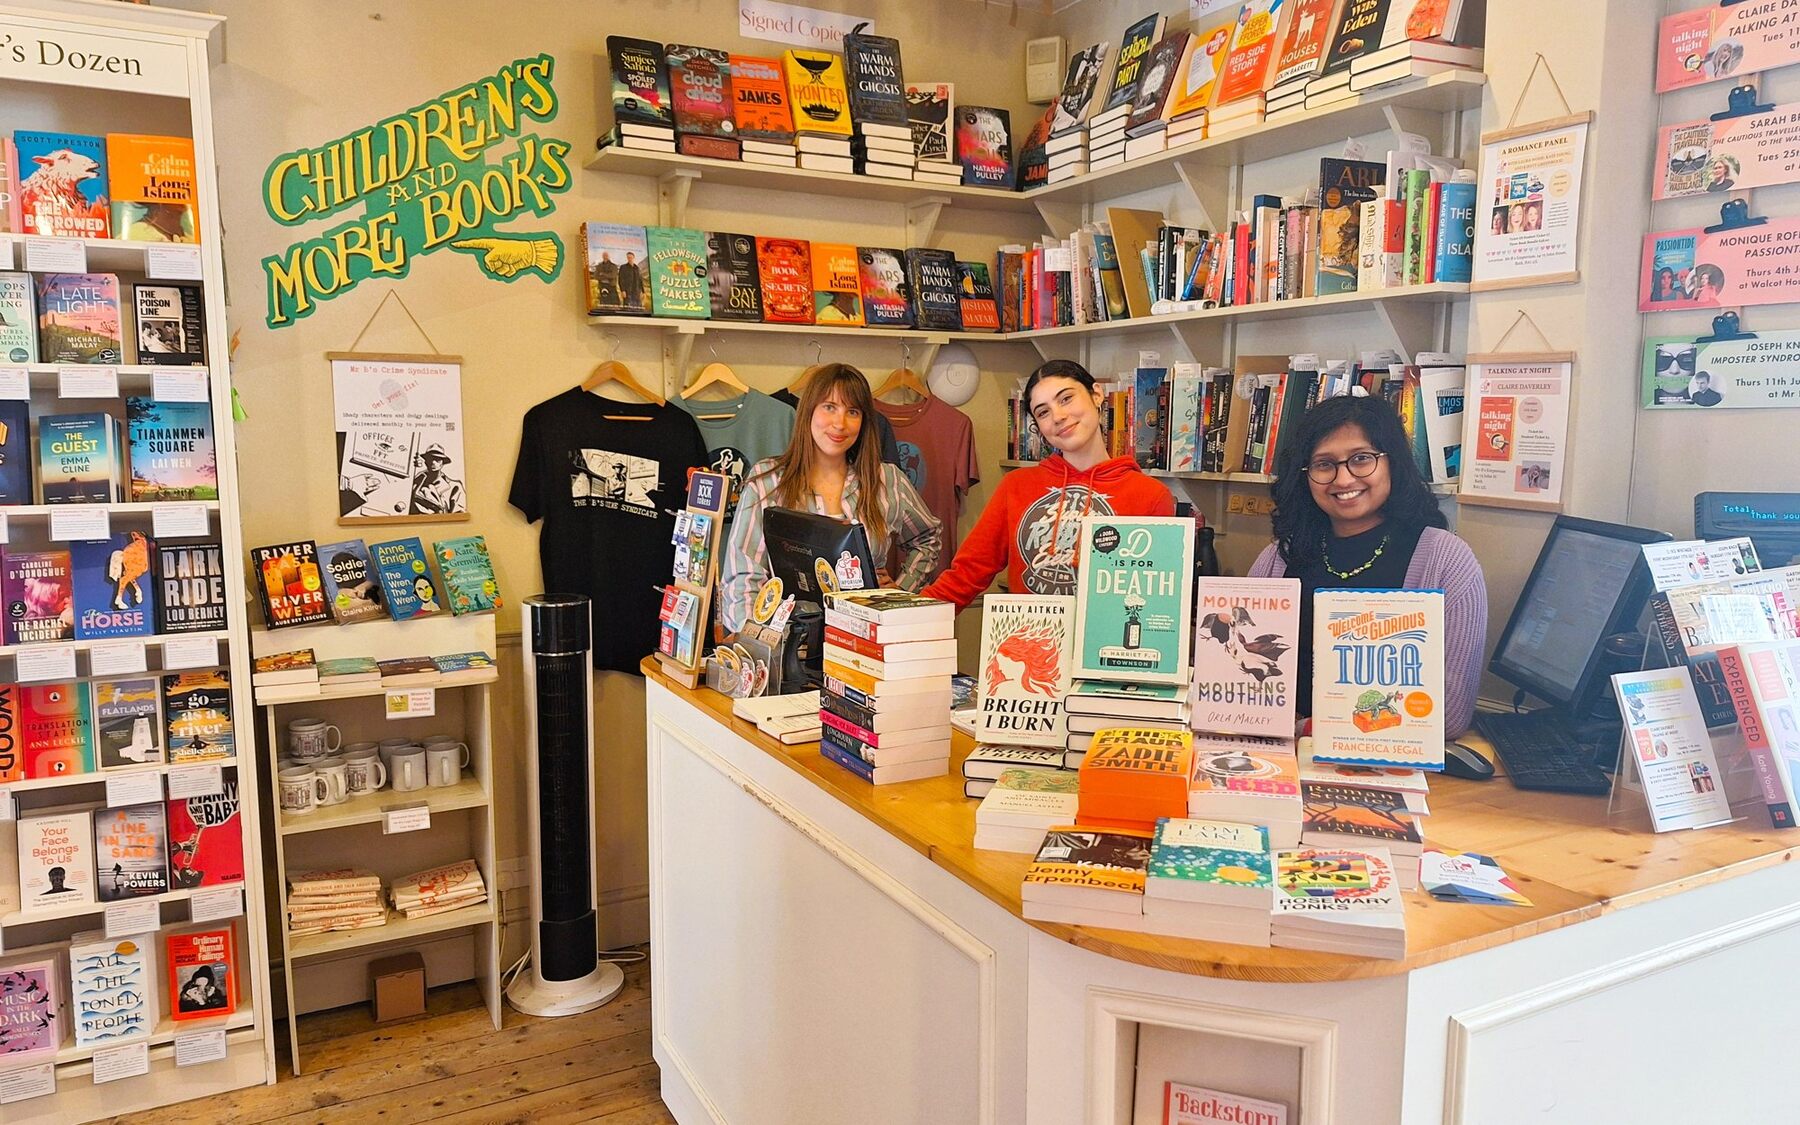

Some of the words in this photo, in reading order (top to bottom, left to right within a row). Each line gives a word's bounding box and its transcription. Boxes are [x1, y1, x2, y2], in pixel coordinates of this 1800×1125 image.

[1737, 2, 1776, 20] CLAIRE
[741, 9, 793, 33] Signed
[1341, 11, 1379, 36] Eden
[1728, 17, 1778, 37] TALKING
[1781, 12, 1797, 24] AT
[1671, 28, 1709, 45] talking
[1763, 32, 1784, 43] Tues
[37, 40, 143, 76] Dozen
[859, 52, 894, 67] WARM
[1280, 42, 1318, 66] HOUSES
[860, 65, 895, 78] HANDS
[1116, 60, 1141, 88] PARTY
[631, 80, 653, 90] HEART
[682, 72, 722, 89] cloud
[859, 80, 900, 96] GHOSTS
[737, 89, 782, 105] JAMES
[1750, 117, 1787, 129] SARAH
[268, 59, 554, 222] CHILDREN'S
[929, 136, 944, 145] Paul
[1727, 133, 1763, 143] CAUTIOUS
[1769, 138, 1782, 146] THE
[925, 142, 947, 152] Lynch
[1508, 141, 1543, 154] ROMANCE
[1544, 137, 1568, 148] PANEL
[1757, 153, 1779, 162] Tues
[975, 172, 1003, 181] PULLEY
[386, 162, 458, 207] AND
[143, 186, 191, 200] Island
[25, 216, 104, 231] BORROWED
[268, 211, 405, 324] MORE
[419, 138, 568, 249] BOOKS
[1656, 237, 1695, 251] PASSIONTIDE
[1719, 233, 1773, 247] MONIQUE
[653, 249, 705, 266] FELLOWSHIP
[771, 266, 799, 276] BOOK
[921, 265, 951, 277] WARM
[1746, 267, 1771, 277] Thurs
[1775, 266, 1791, 275] 4th
[660, 275, 701, 288] PUZZLE
[829, 279, 858, 290] Island
[833, 272, 857, 284] Long
[921, 275, 953, 288] HANDS
[1739, 281, 1748, 290] at
[1751, 279, 1783, 289] Walcot
[61, 287, 101, 301] LATE
[139, 290, 156, 299] THE
[659, 287, 703, 300] MAKERS
[730, 286, 756, 299] DAY
[921, 291, 957, 304] GHOSTS
[57, 301, 108, 314] LIGHT
[139, 299, 171, 308] POISON
[729, 297, 758, 309] ONE
[873, 304, 905, 313] NATASHA
[140, 307, 160, 316] LINE
[876, 310, 904, 319] PULLEY
[67, 336, 102, 344] MICHAEL
[72, 341, 98, 349] MALAY
[1746, 342, 1782, 352] JOSEPH
[1711, 356, 1757, 365] IMPOSTER
[1736, 378, 1761, 387] Thurs
[1765, 377, 1786, 387] 11th
[1781, 390, 1795, 398] Mr
[1481, 411, 1512, 422] talking
[1484, 420, 1507, 430] night
[65, 432, 83, 441] THE
[137, 428, 206, 441] TIANANMEN
[362, 433, 394, 444] OFFICES
[51, 439, 98, 454] GUEST
[149, 440, 195, 454] SQUARE
[61, 456, 91, 466] EMMA
[152, 458, 167, 468] LAI
[62, 464, 91, 473] CLINE
[621, 504, 658, 519] SYNDICATE
[1094, 535, 1118, 544] WILDWOOD
[1119, 528, 1152, 558] D
[260, 543, 314, 561] RIVER
[378, 544, 405, 556] Anne
[162, 550, 222, 579] DARK
[380, 551, 415, 566] Enright
[1131, 560, 1153, 568] FOR
[326, 559, 368, 575] Soldier
[334, 570, 368, 583] Sailor
[386, 572, 401, 581] The
[1096, 569, 1175, 596] DEATH
[165, 577, 224, 607] RIDE
[391, 589, 407, 598] The
[270, 592, 324, 608] RIVER
[394, 596, 416, 606] Wren
[1203, 595, 1291, 611] MOUTHING
[341, 608, 361, 617] Claire
[991, 605, 1022, 613] MOLLY
[1027, 605, 1065, 614] AITKEN
[12, 621, 31, 631] THE
[81, 611, 144, 629] HORSE
[1327, 611, 1375, 638] WELCOME
[1369, 611, 1425, 641] GLORIOUS
[19, 629, 62, 641] INCIDENT
[1110, 651, 1142, 659] HARRIET
[1112, 659, 1149, 667] TOWNSON
[1332, 643, 1424, 687] TUGA
[1723, 655, 1761, 743] EXPERIENCED
[102, 704, 155, 715] FLATLANDS
[983, 698, 1062, 716] BRIGHT
[26, 718, 89, 731] TRANSLATION
[999, 715, 1055, 731] BURN
[1207, 711, 1231, 723] ORLA
[1237, 712, 1273, 726] MACKEY
[37, 729, 76, 739] STATE
[178, 722, 223, 737] river
[29, 740, 49, 749] ANN
[1098, 736, 1184, 747] FRAUD
[1093, 747, 1181, 763] ZADIE
[1332, 741, 1390, 754] FRANCESCA
[1393, 742, 1424, 756] SEGAL
[1088, 759, 1178, 772] SMITH
[1758, 754, 1768, 774] Kate
[1765, 775, 1776, 800] Young
[1227, 777, 1297, 794] RED
[1308, 785, 1394, 800] Roman
[205, 801, 239, 825] BABY
[42, 826, 67, 837] Your
[1186, 823, 1241, 835] TOM
[41, 836, 69, 846] Face
[1178, 830, 1248, 843] LAKE
[32, 844, 79, 858] Belongs
[41, 856, 55, 865] To
[58, 855, 72, 864] Us
[129, 871, 159, 880] KEVIN
[1028, 865, 1093, 878] Jenny
[124, 879, 166, 888] POWERS
[1023, 874, 1144, 891] Erpenbeck
[1278, 897, 1392, 905] ROSEMARY
[1280, 903, 1351, 911] TONKS
[198, 952, 225, 962] Failings
[81, 992, 142, 1011] LONELY
[85, 1013, 141, 1031] PEOPLE
